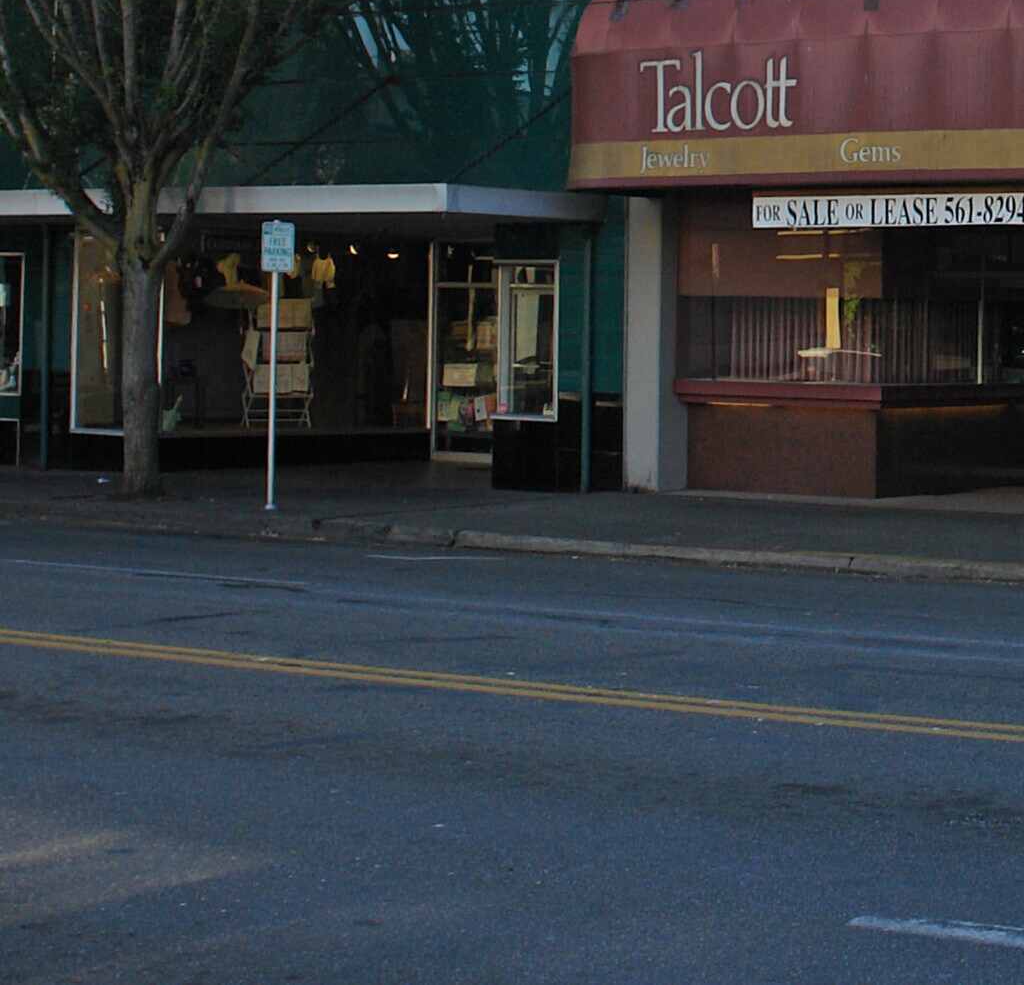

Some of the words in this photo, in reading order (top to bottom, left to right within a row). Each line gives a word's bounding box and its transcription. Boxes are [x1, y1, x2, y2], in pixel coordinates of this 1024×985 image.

[640, 50, 797, 133] Talcott
[640, 144, 711, 173] Jewelry
[839, 137, 901, 163] Gems
[756, 204, 780, 221] FOR
[786, 198, 839, 226] SALE
[845, 202, 864, 220] OR
[870, 197, 939, 226] LEASE
